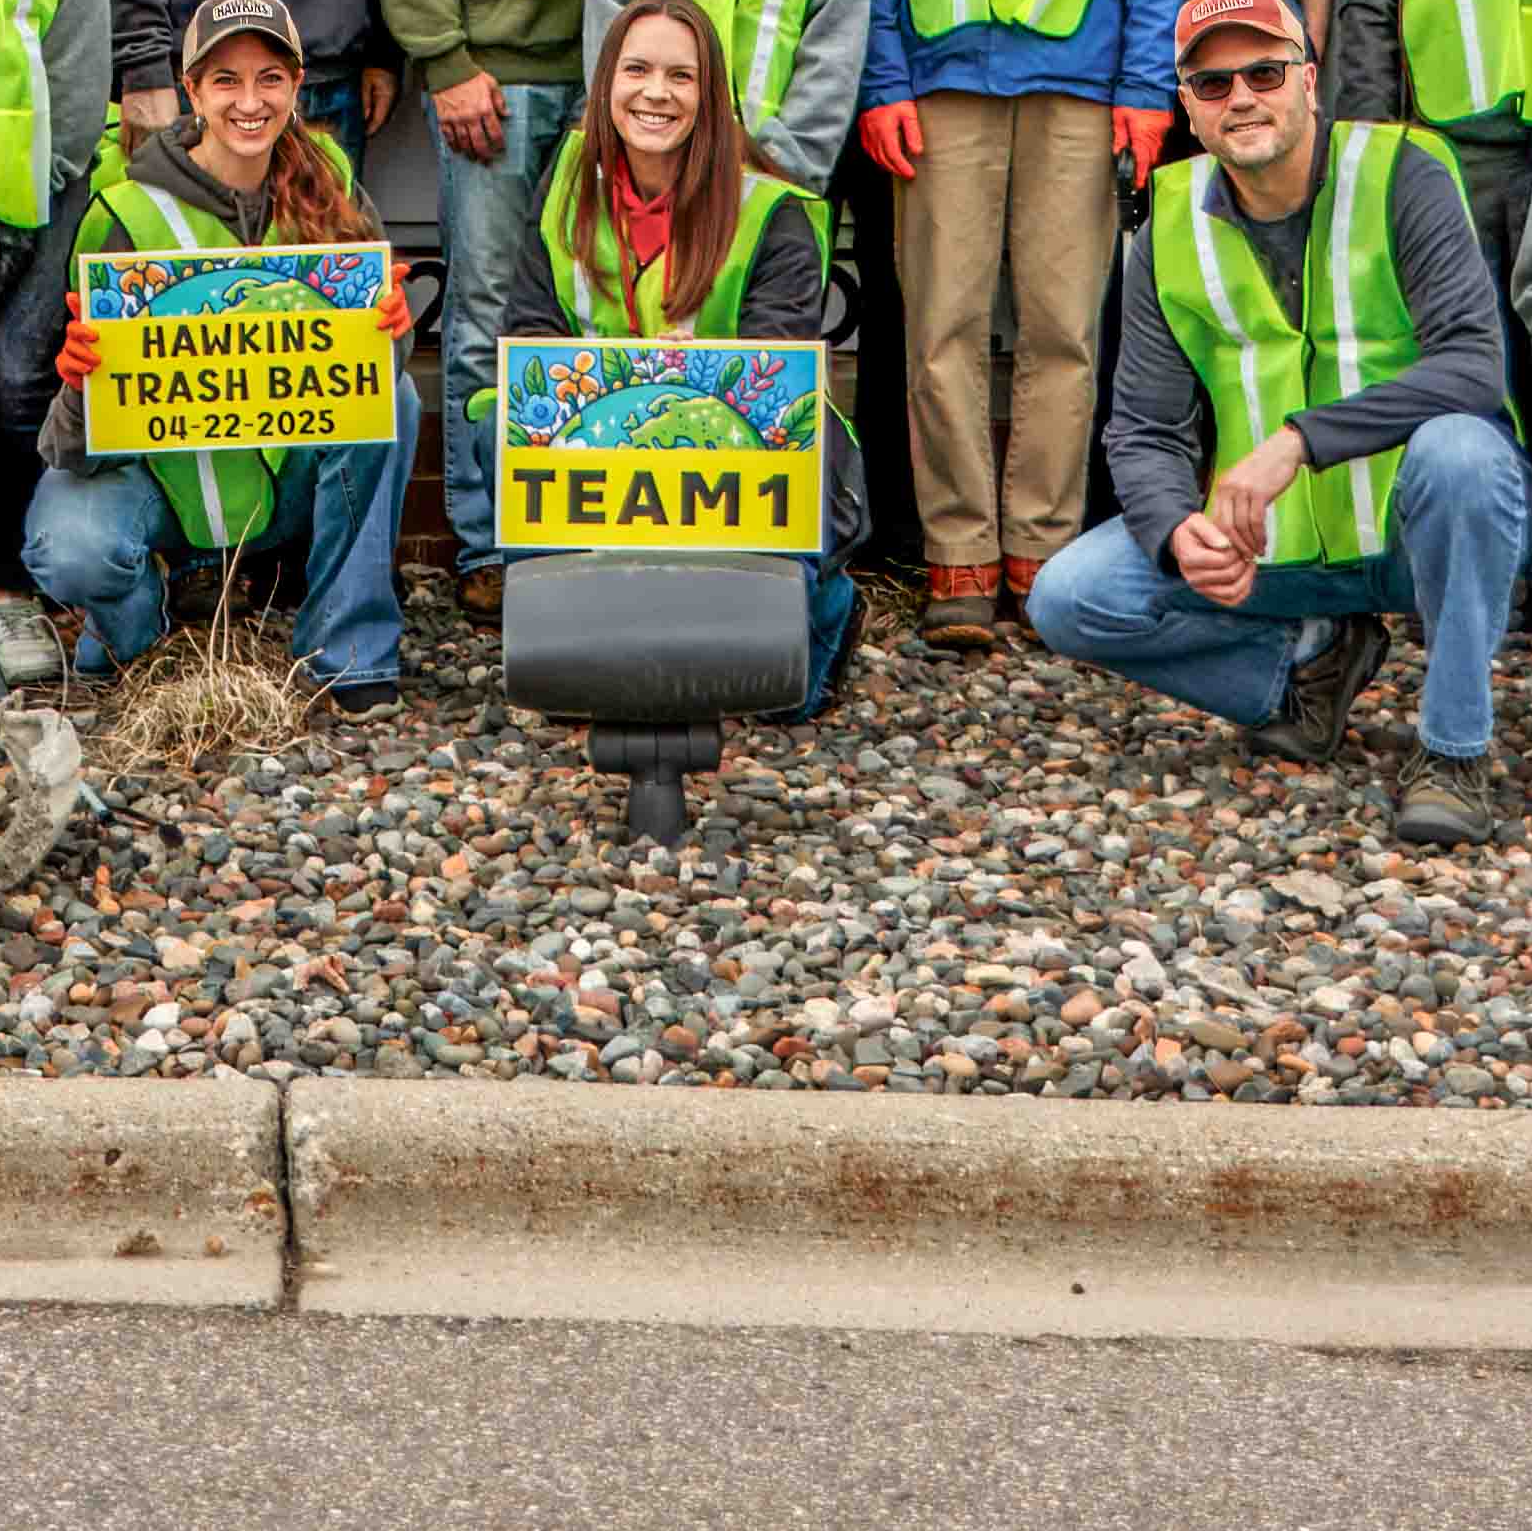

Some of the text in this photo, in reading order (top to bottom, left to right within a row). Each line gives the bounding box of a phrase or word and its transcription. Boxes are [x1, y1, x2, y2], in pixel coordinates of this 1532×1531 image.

[141, 318, 334, 360] HAWKINS
[110, 362, 381, 407] TRASH BASH
[147, 408, 336, 442] 04-22-2025
[512, 468, 790, 528] TEAM 1
